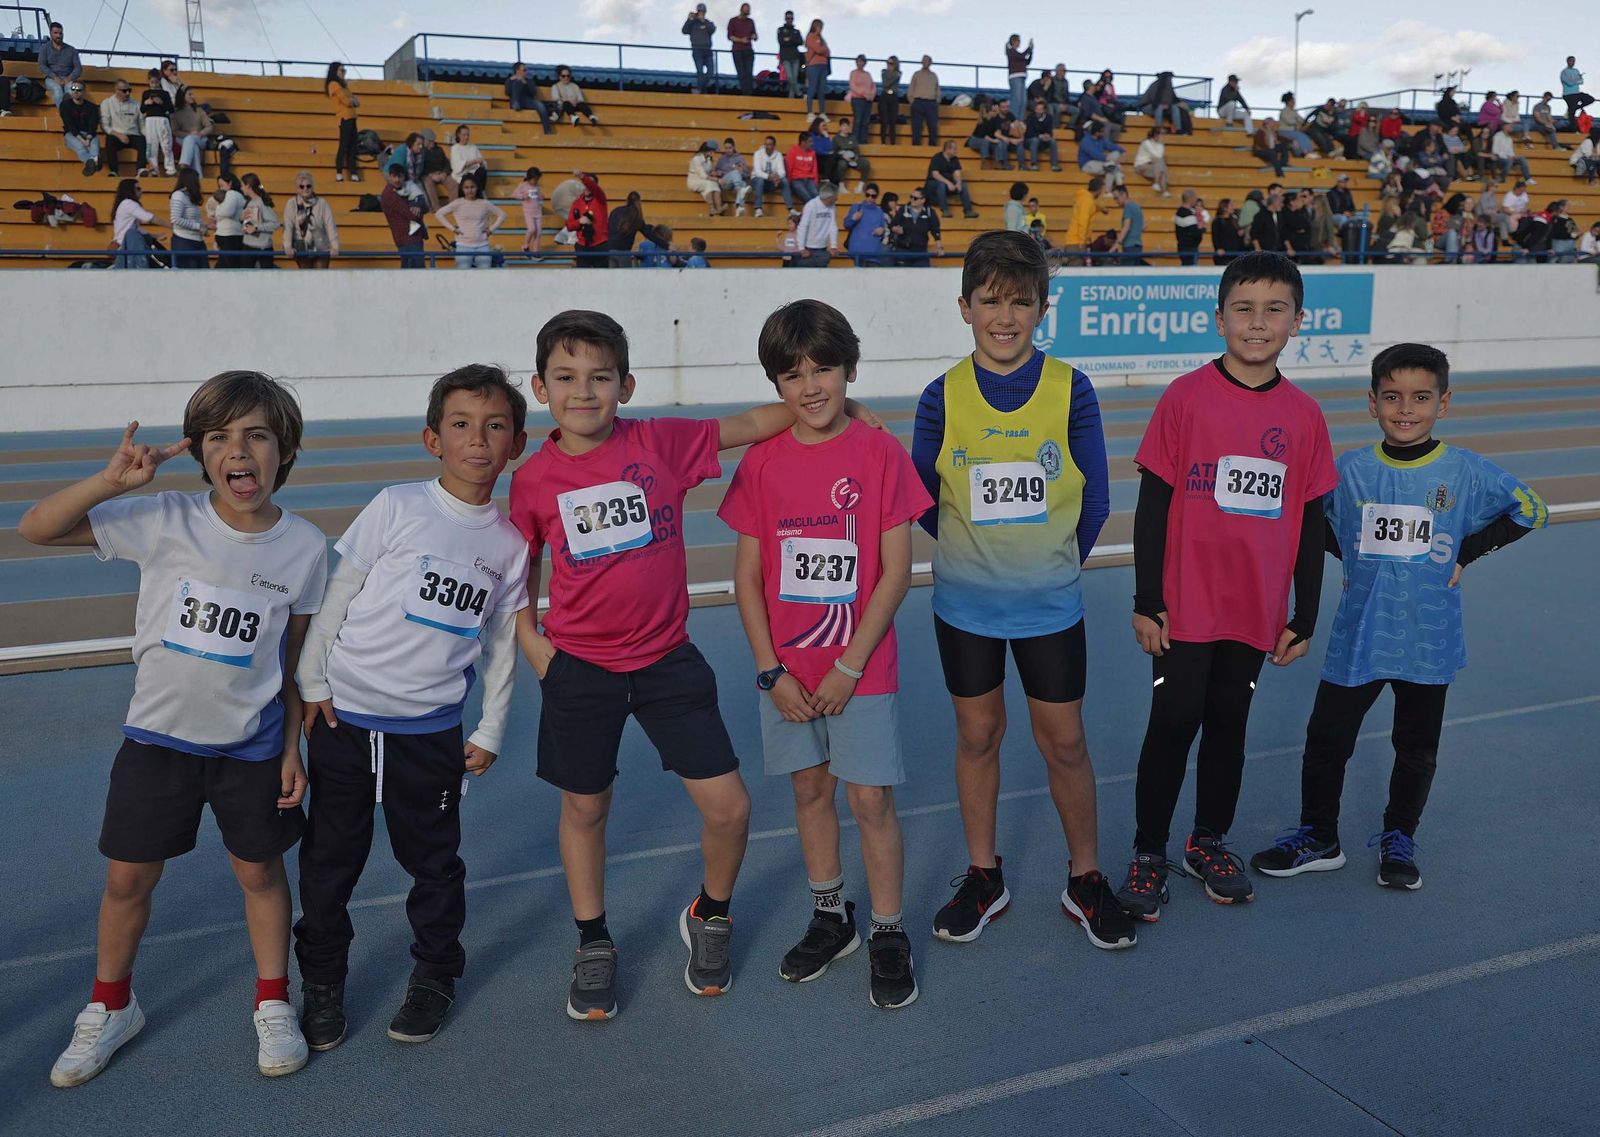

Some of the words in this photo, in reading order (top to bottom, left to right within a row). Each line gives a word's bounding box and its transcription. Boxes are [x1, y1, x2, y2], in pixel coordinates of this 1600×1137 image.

[1080, 285, 1143, 301] ESTADIO
[1080, 303, 1209, 342] Enrique
[1078, 361, 1136, 372] BALONMANO
[982, 476, 1044, 504] 3249
[1227, 469, 1282, 499] 3233
[573, 494, 647, 535] 3235
[1374, 517, 1432, 543] 3314
[795, 553, 857, 582] 3237
[259, 579, 289, 595] attendis
[419, 571, 489, 617] 3304
[179, 597, 261, 643] 3303
